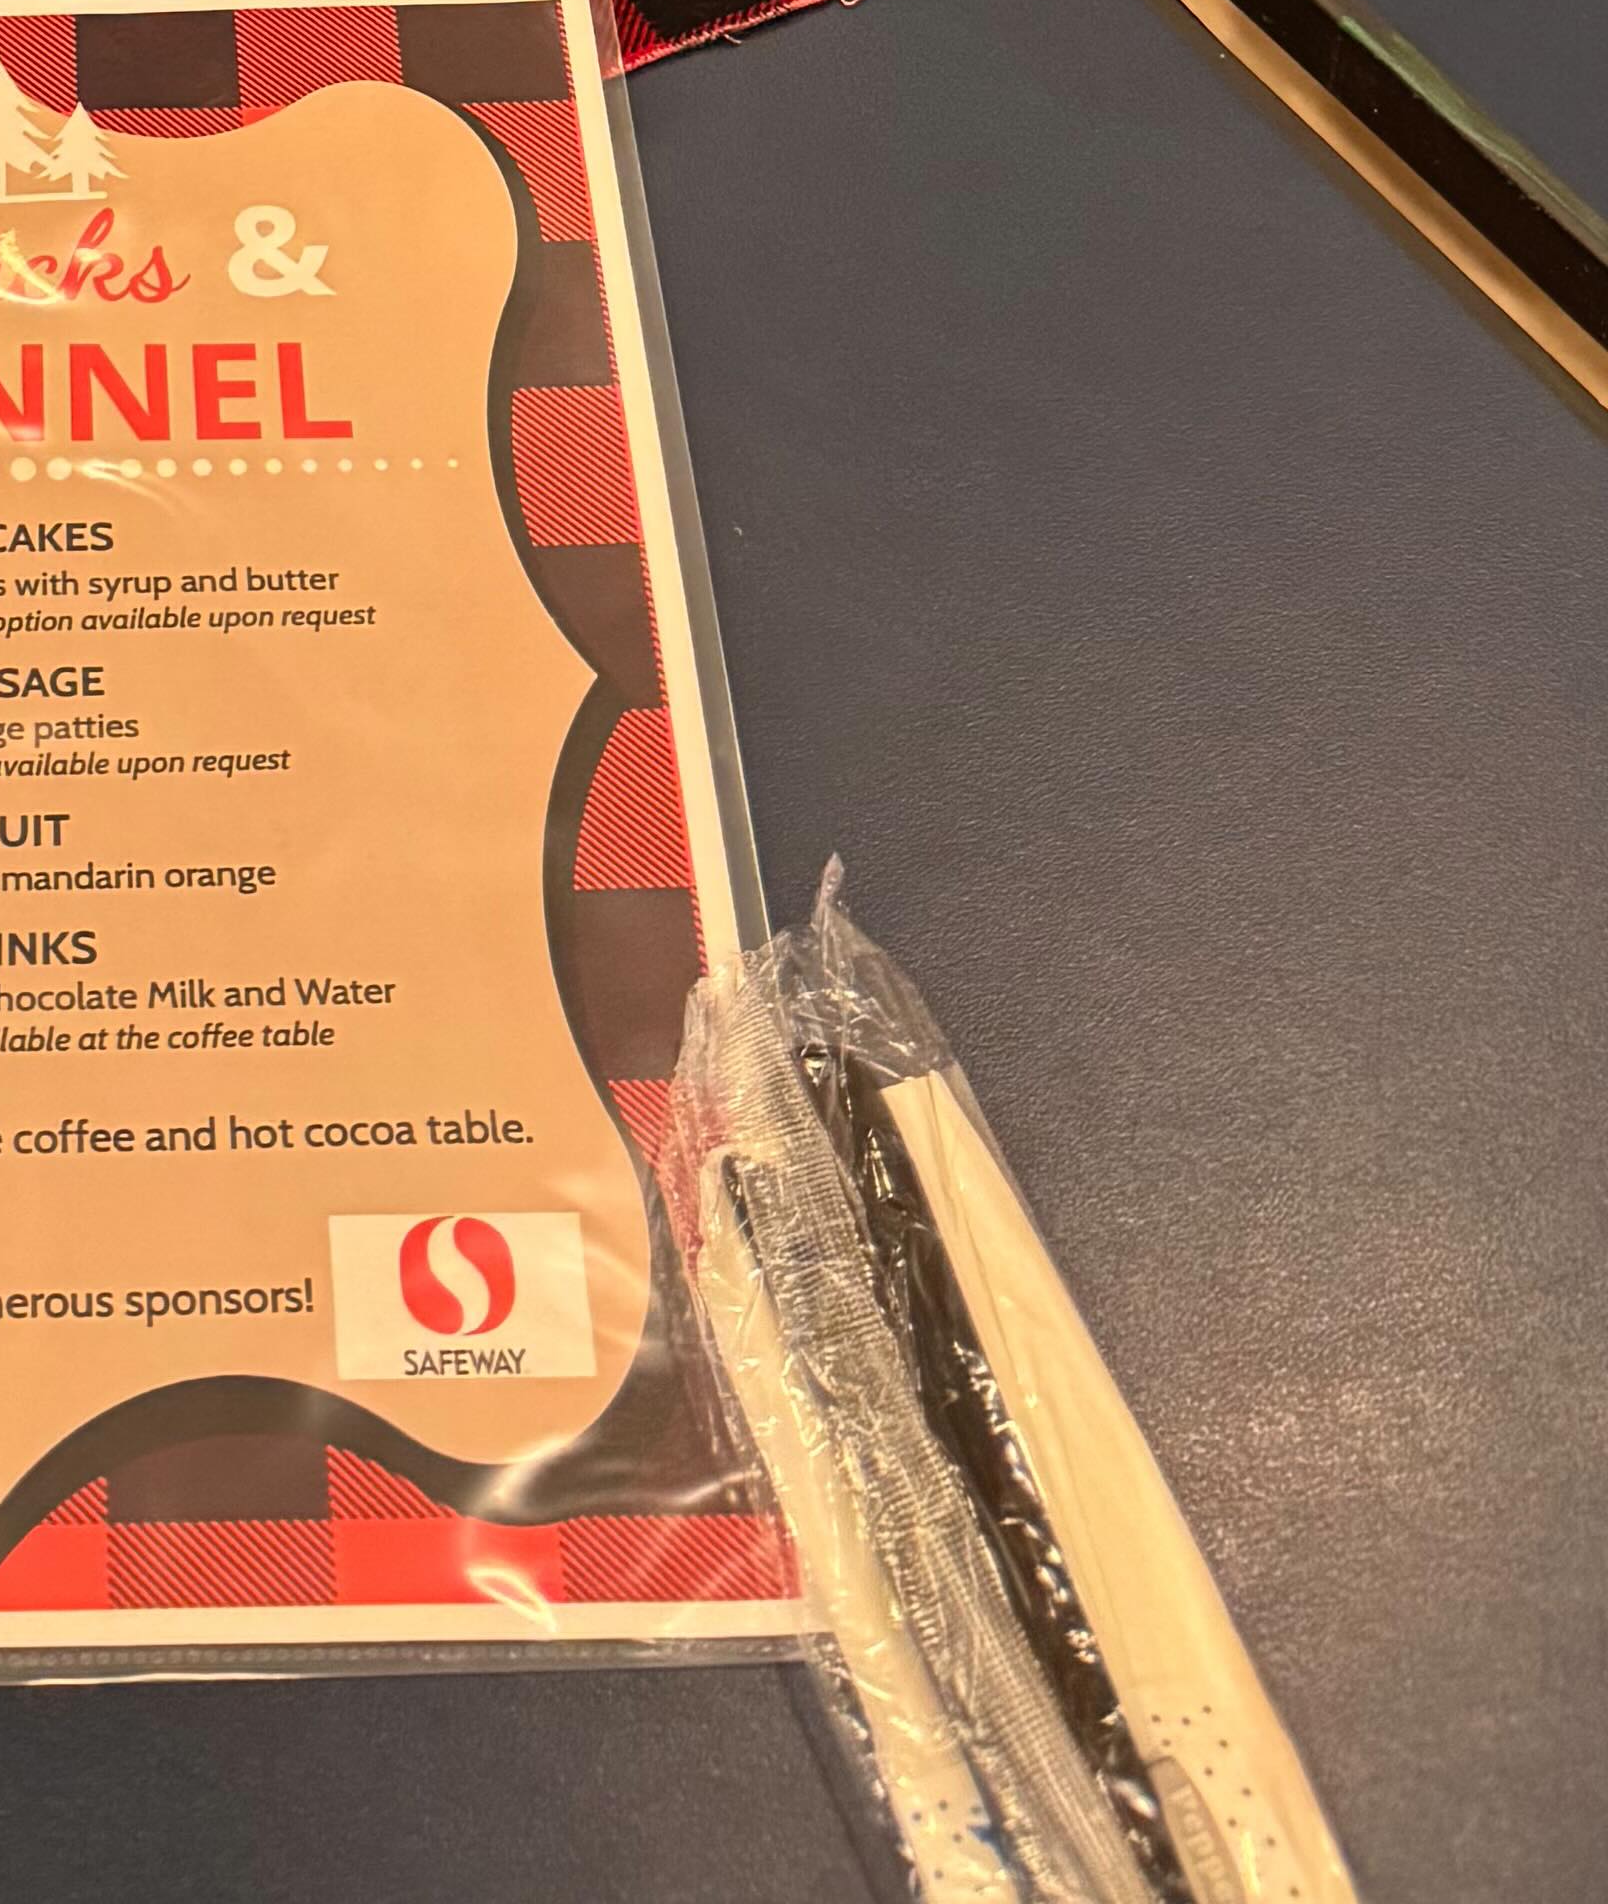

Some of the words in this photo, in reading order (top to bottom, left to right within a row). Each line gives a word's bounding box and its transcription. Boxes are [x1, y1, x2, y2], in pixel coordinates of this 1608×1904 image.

[226, 203, 338, 298] &
[13, 568, 80, 597] with
[87, 575, 173, 605] syrup
[180, 566, 239, 593] and
[246, 565, 340, 592] butter
[80, 605, 202, 631] available
[208, 610, 275, 634] upon
[280, 605, 377, 634] request
[33, 714, 140, 748] patties
[116, 755, 186, 781] upon
[191, 749, 292, 781] request
[1, 860, 156, 892] mandarin
[164, 865, 277, 895] orange
[147, 978, 217, 1009] Milk
[223, 975, 287, 1008] and
[293, 976, 397, 1006] Water
[77, 1026, 110, 1051] at
[115, 1023, 161, 1051] the
[167, 1020, 255, 1050] coffee
[260, 1018, 336, 1048] table
[12, 1118, 136, 1155] coffee
[144, 1114, 217, 1152] and
[229, 1113, 295, 1150] hot
[303, 1120, 418, 1148] cocoa
[425, 1107, 534, 1145] table.
[124, 1277, 314, 1327] sponsors!
[403, 1347, 527, 1376] SAFEWAY
